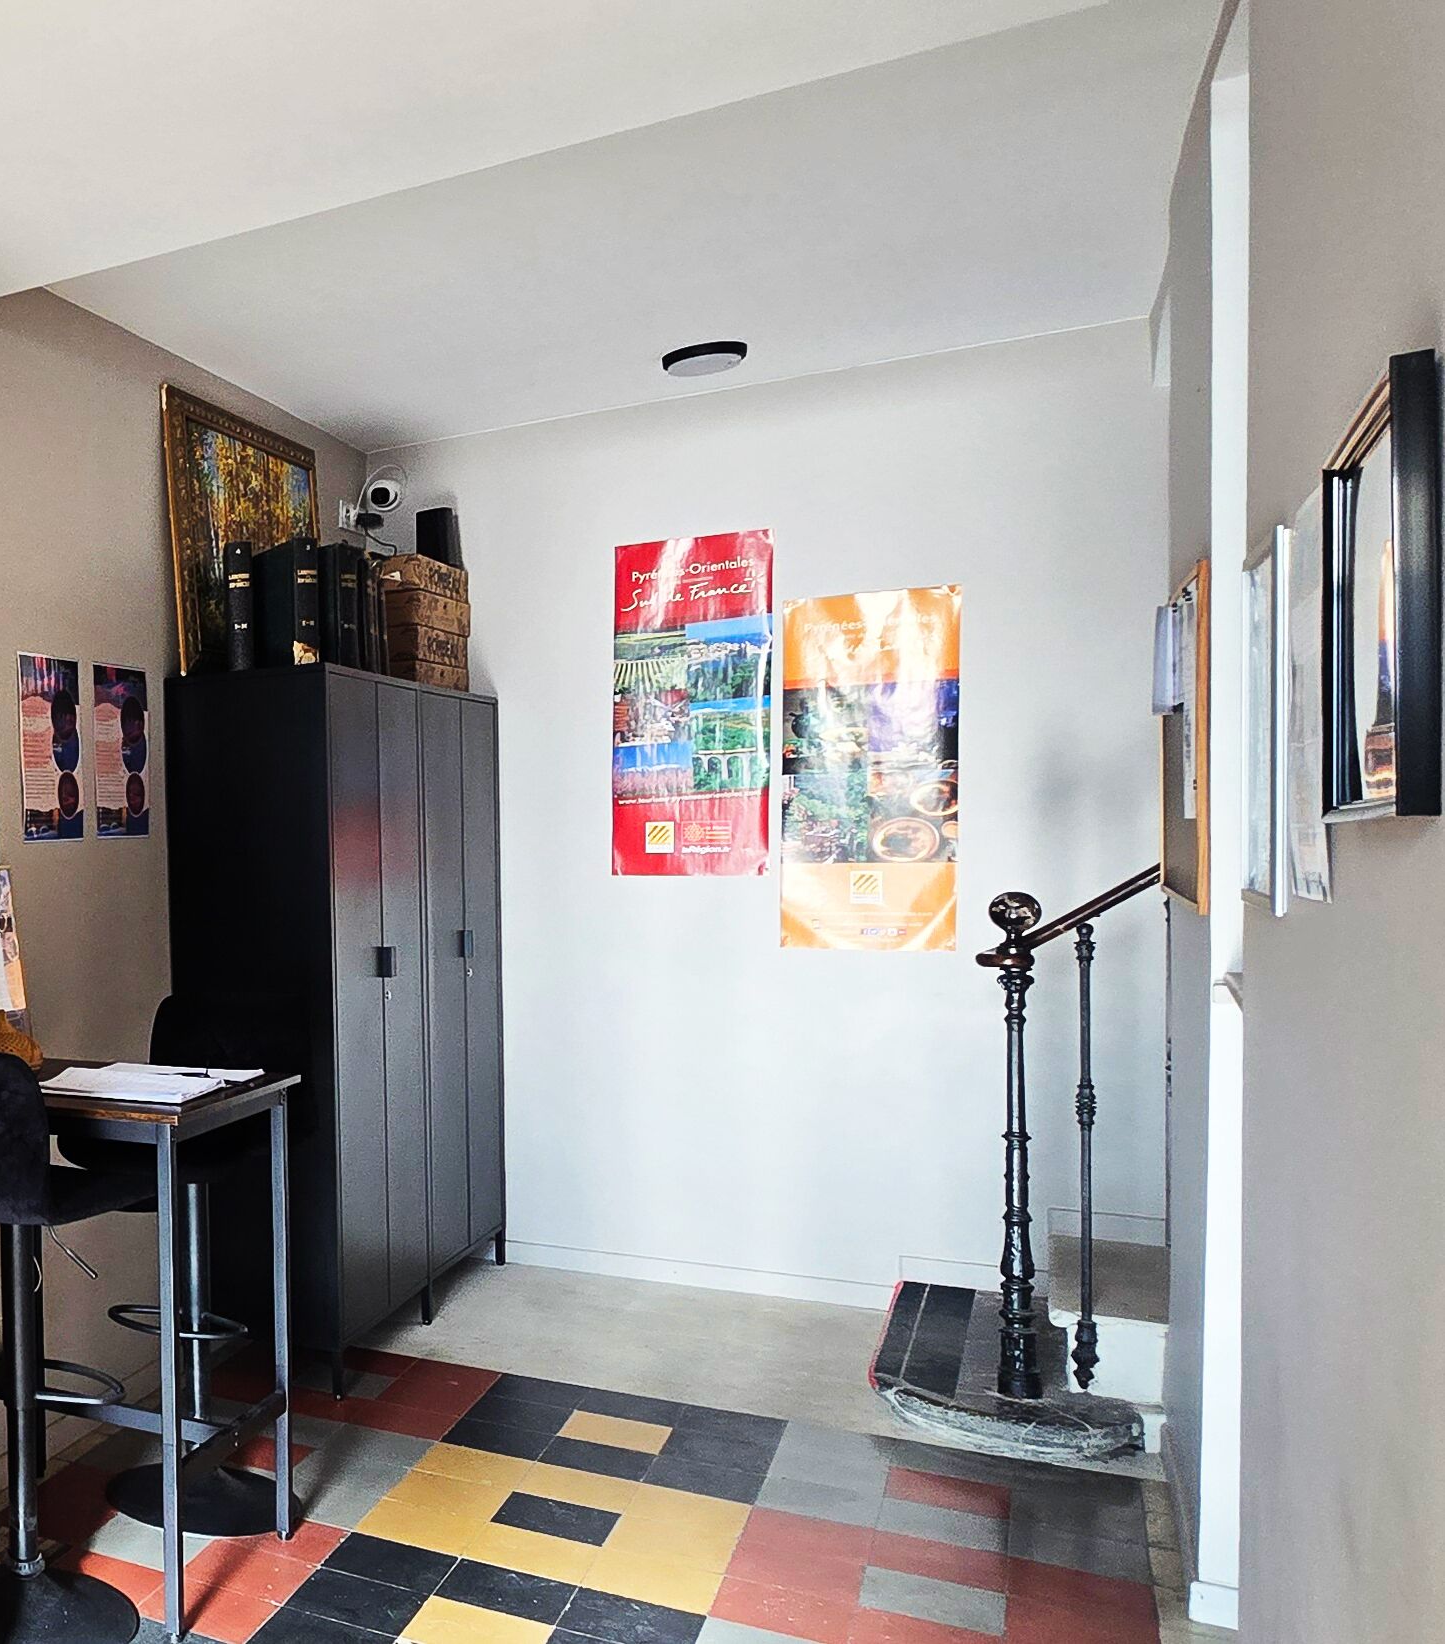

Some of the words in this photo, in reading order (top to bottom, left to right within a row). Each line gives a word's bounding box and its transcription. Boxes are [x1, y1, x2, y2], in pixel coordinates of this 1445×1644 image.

[631, 556, 754, 584] Pyrés-Orientales
[689, 581, 753, 600] France
[805, 613, 940, 634] Pyrénées-les
